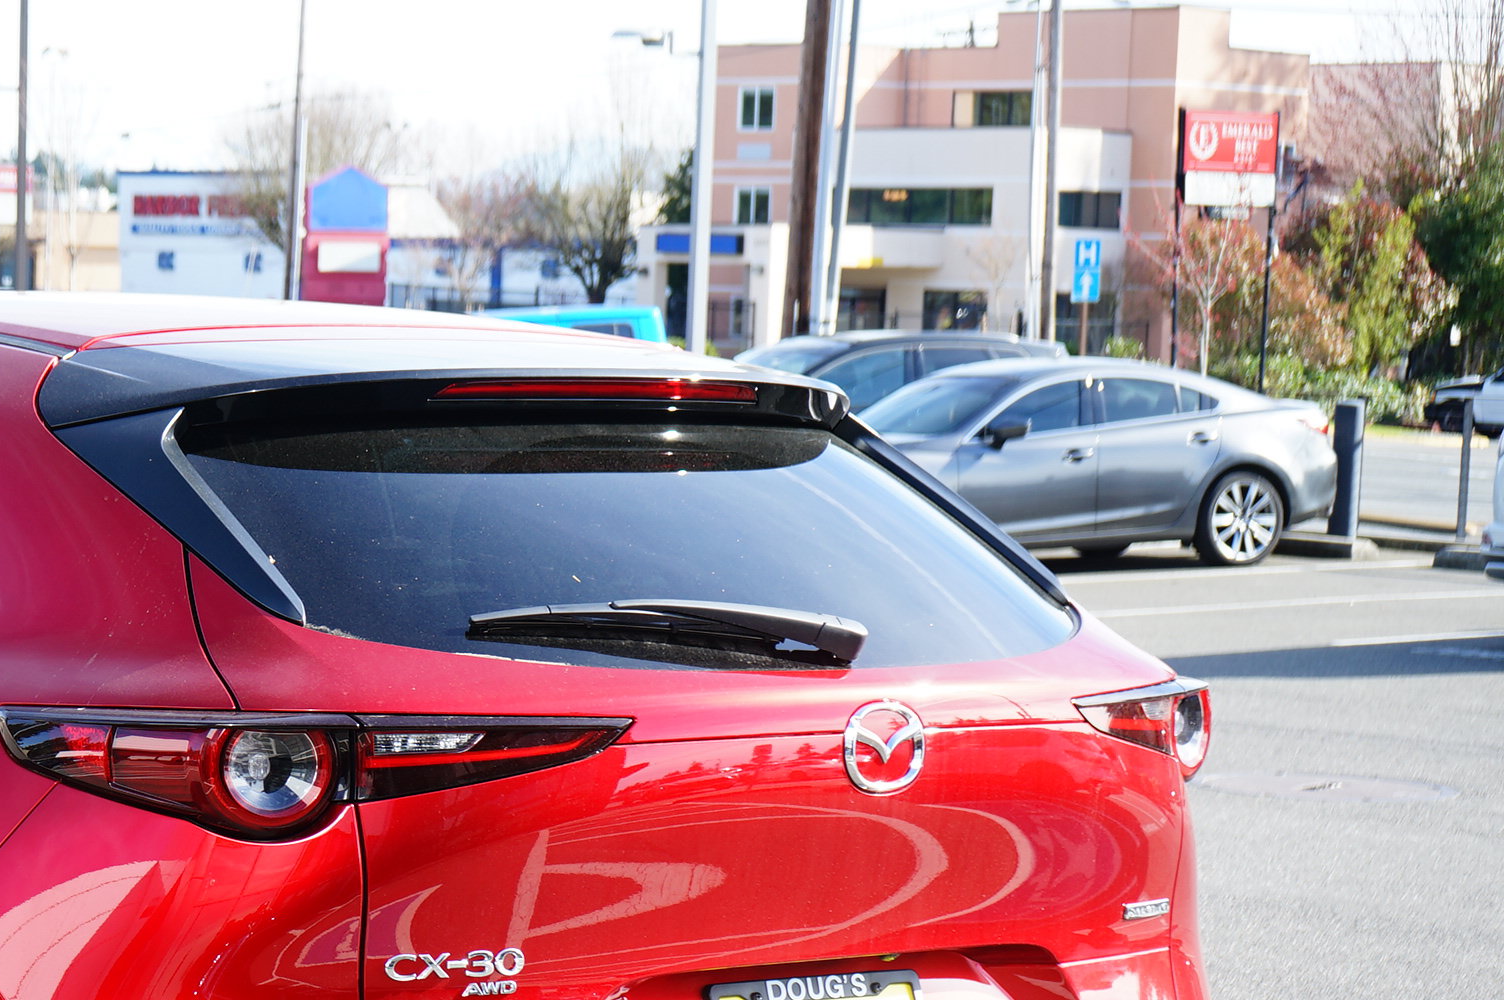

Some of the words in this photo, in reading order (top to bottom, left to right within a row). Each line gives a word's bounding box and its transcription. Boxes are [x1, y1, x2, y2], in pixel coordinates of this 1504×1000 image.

[1078, 241, 1097, 267] H
[384, 947, 525, 982] CX-30
[461, 979, 518, 998] AWD
